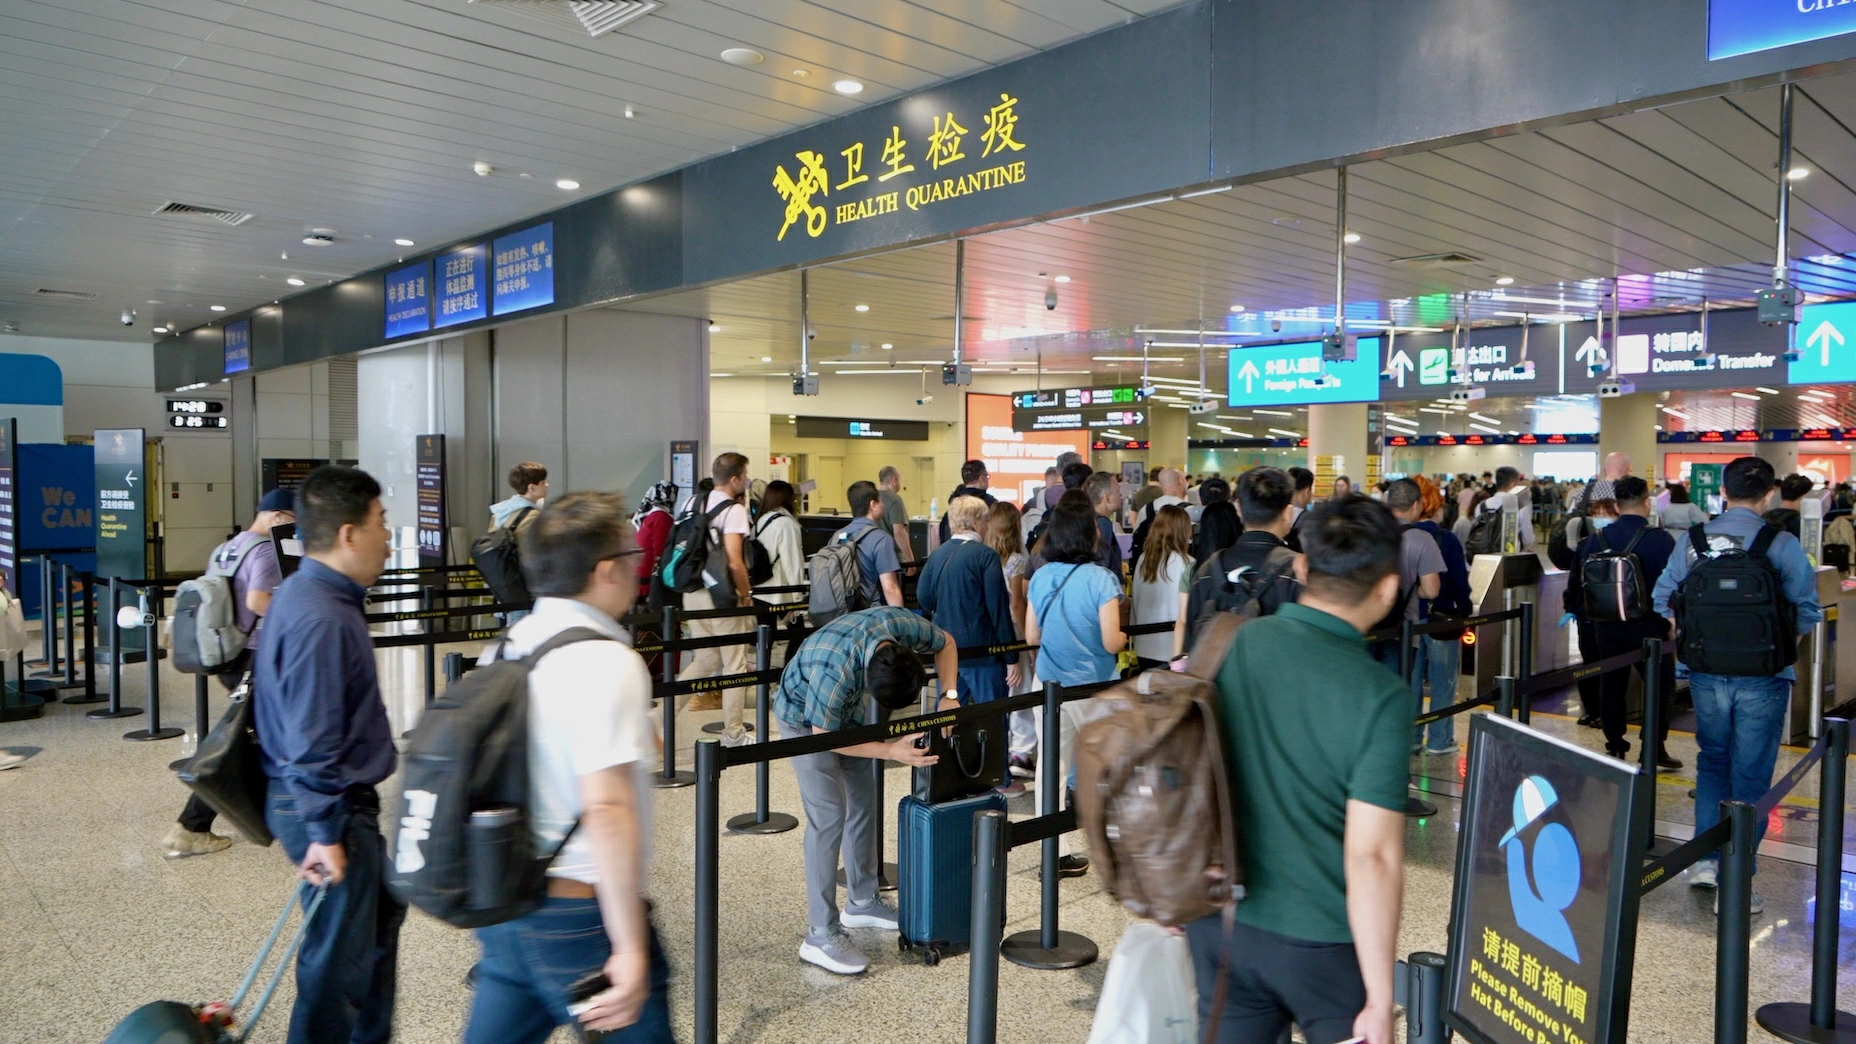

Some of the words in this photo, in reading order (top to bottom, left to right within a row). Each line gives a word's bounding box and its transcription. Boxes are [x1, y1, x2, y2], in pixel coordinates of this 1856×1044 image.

[835, 92, 1026, 191] 卫生检疫
[835, 191, 898, 224] HEALTH
[905, 161, 1026, 210] QUARANTINE
[445, 255, 474, 277] 正在进行
[388, 276, 425, 304] 申报通道
[446, 273, 475, 296] 体温监测
[442, 291, 479, 315] 请按序通过
[1717, 352, 1776, 370] Transfer
[1264, 379, 1297, 392] Foreign
[1473, 368, 1491, 382] for
[41, 486, 76, 506] We
[41, 508, 92, 529] CAN
[101, 522, 127, 531] Quarantine
[719, 679, 736, 687] CHINA
[735, 676, 758, 685] CUSTOMS
[917, 719, 934, 728] CHINA
[933, 714, 957, 724] CUSTOMS
[1644, 867, 1665, 885] CUSTOMS
[1482, 926, 1587, 1024] 请提前摘帽
[1470, 958, 1507, 997] Please
[1509, 986, 1560, 1036] Remove
[1470, 982, 1492, 1011] Hat
[1493, 999, 1535, 1042] Before
